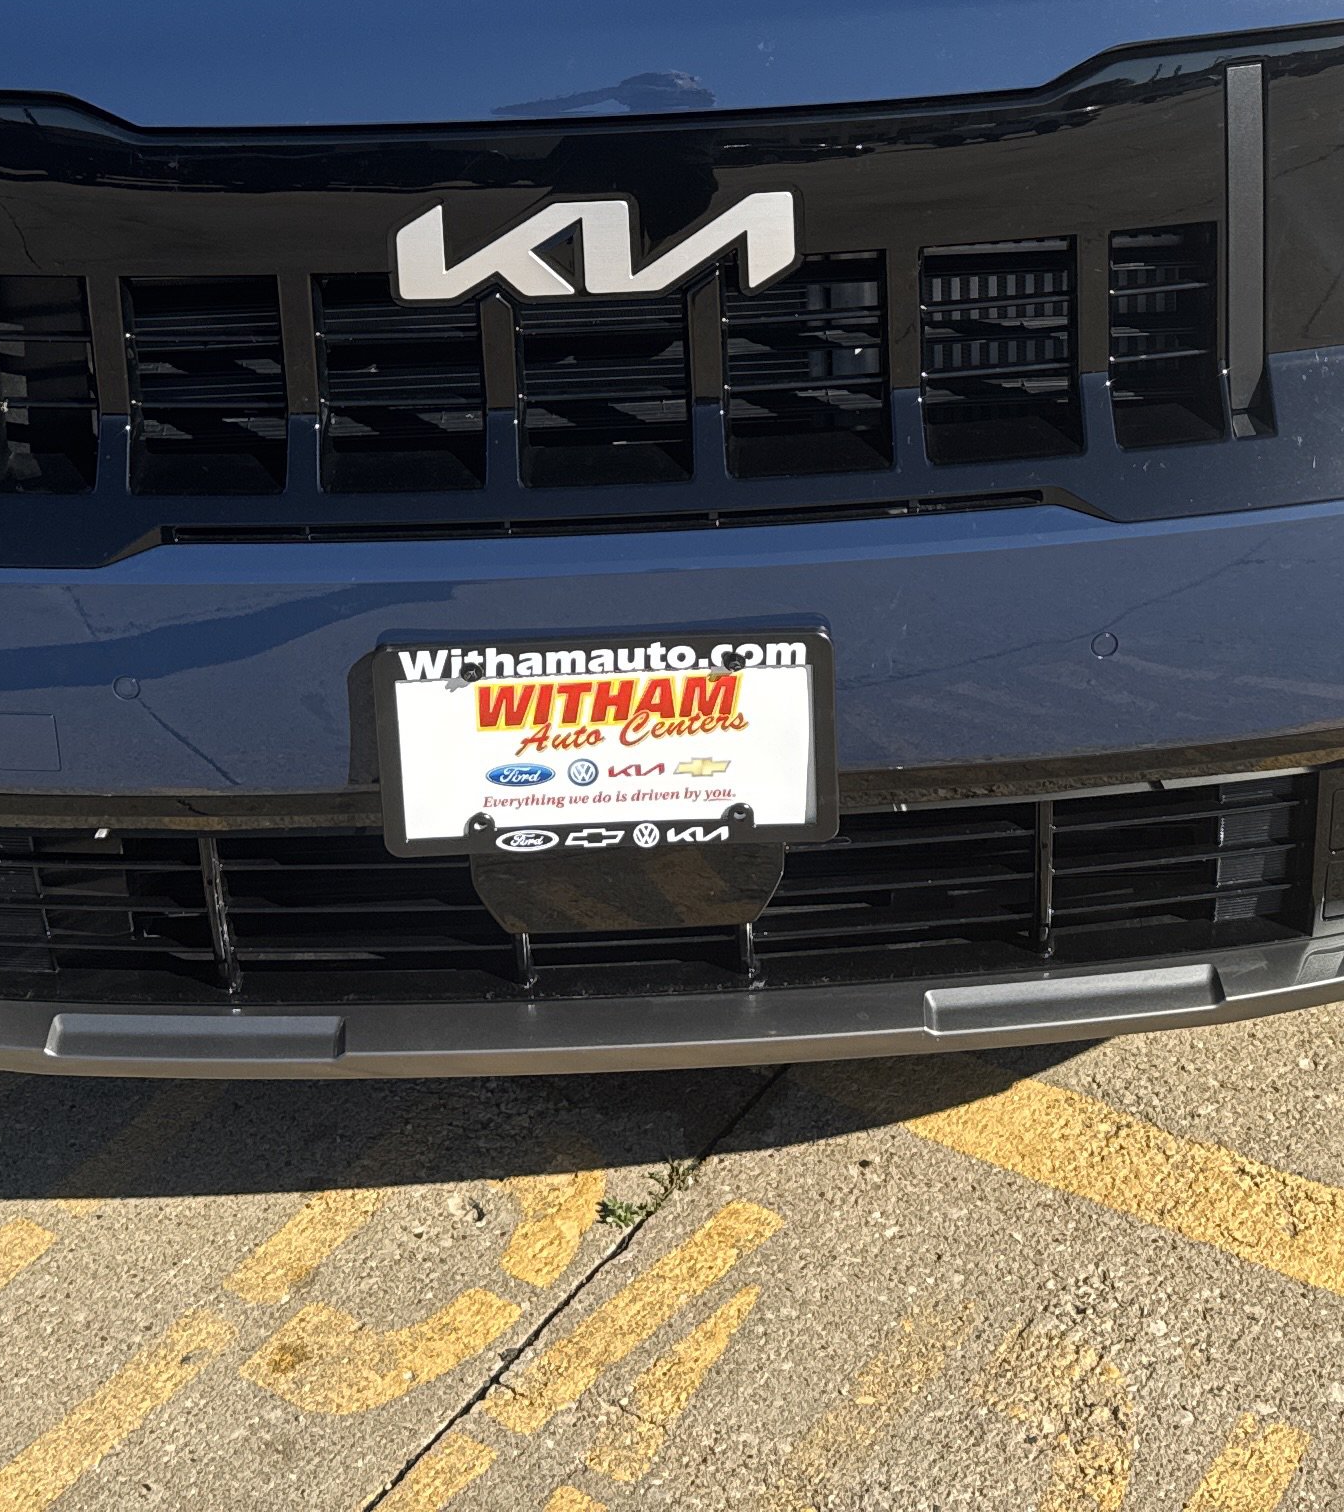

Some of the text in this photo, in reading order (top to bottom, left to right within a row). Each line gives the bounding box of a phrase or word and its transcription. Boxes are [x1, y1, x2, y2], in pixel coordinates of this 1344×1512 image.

[396, 191, 796, 300] KIA
[398, 641, 807, 681] Withamauto.com
[477, 674, 741, 730] WITHAM
[514, 710, 749, 757] Auto Centers
[483, 786, 737, 810] Everything we do is driven by you.
